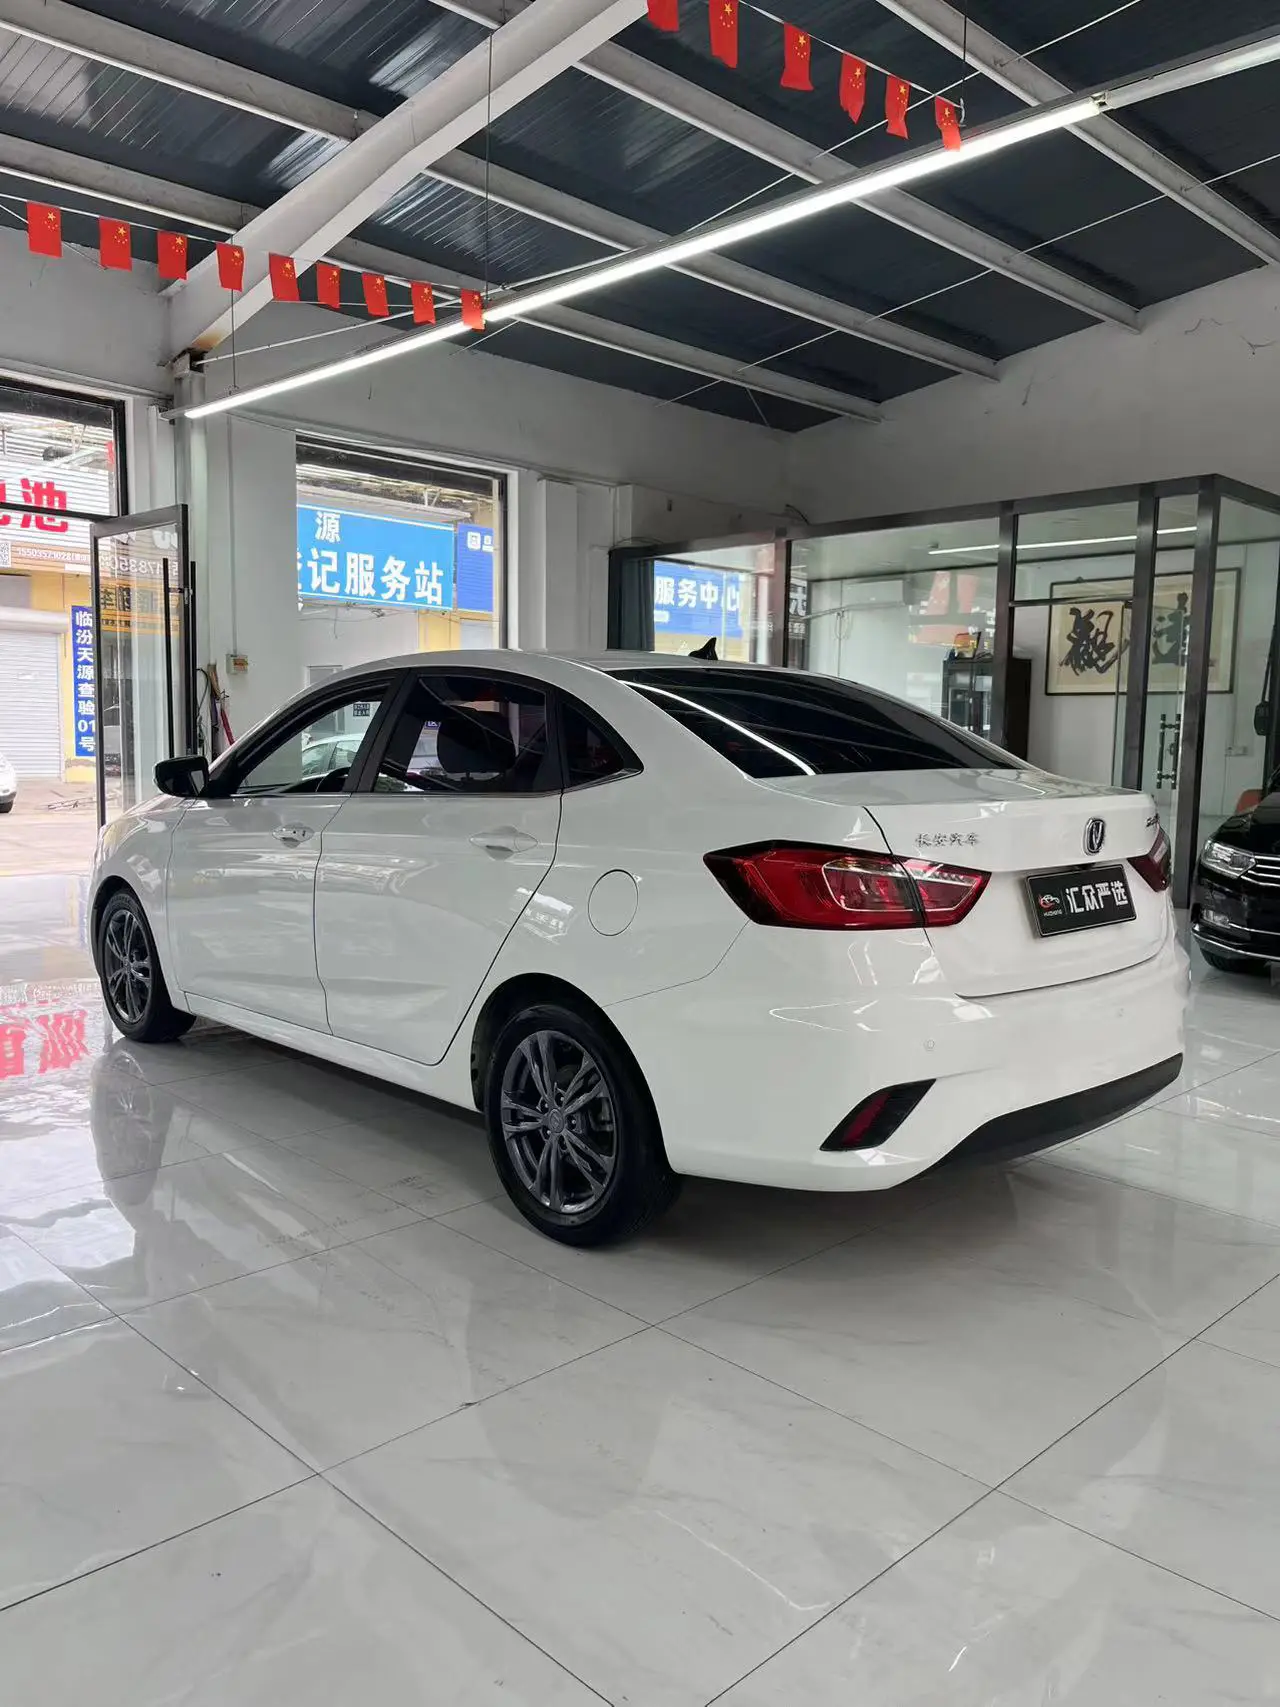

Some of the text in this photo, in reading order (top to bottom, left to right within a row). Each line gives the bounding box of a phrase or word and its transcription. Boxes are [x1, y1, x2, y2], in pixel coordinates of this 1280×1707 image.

[0, 478, 69, 533] 池
[315, 511, 341, 543] 源
[297, 547, 444, 605] 记服务站
[655, 576, 740, 611] 服务中心
[75, 611, 97, 752] 临汾天源查验01号
[915, 831, 980, 848] 长安汽车
[1065, 880, 1128, 914] 汇众严选
